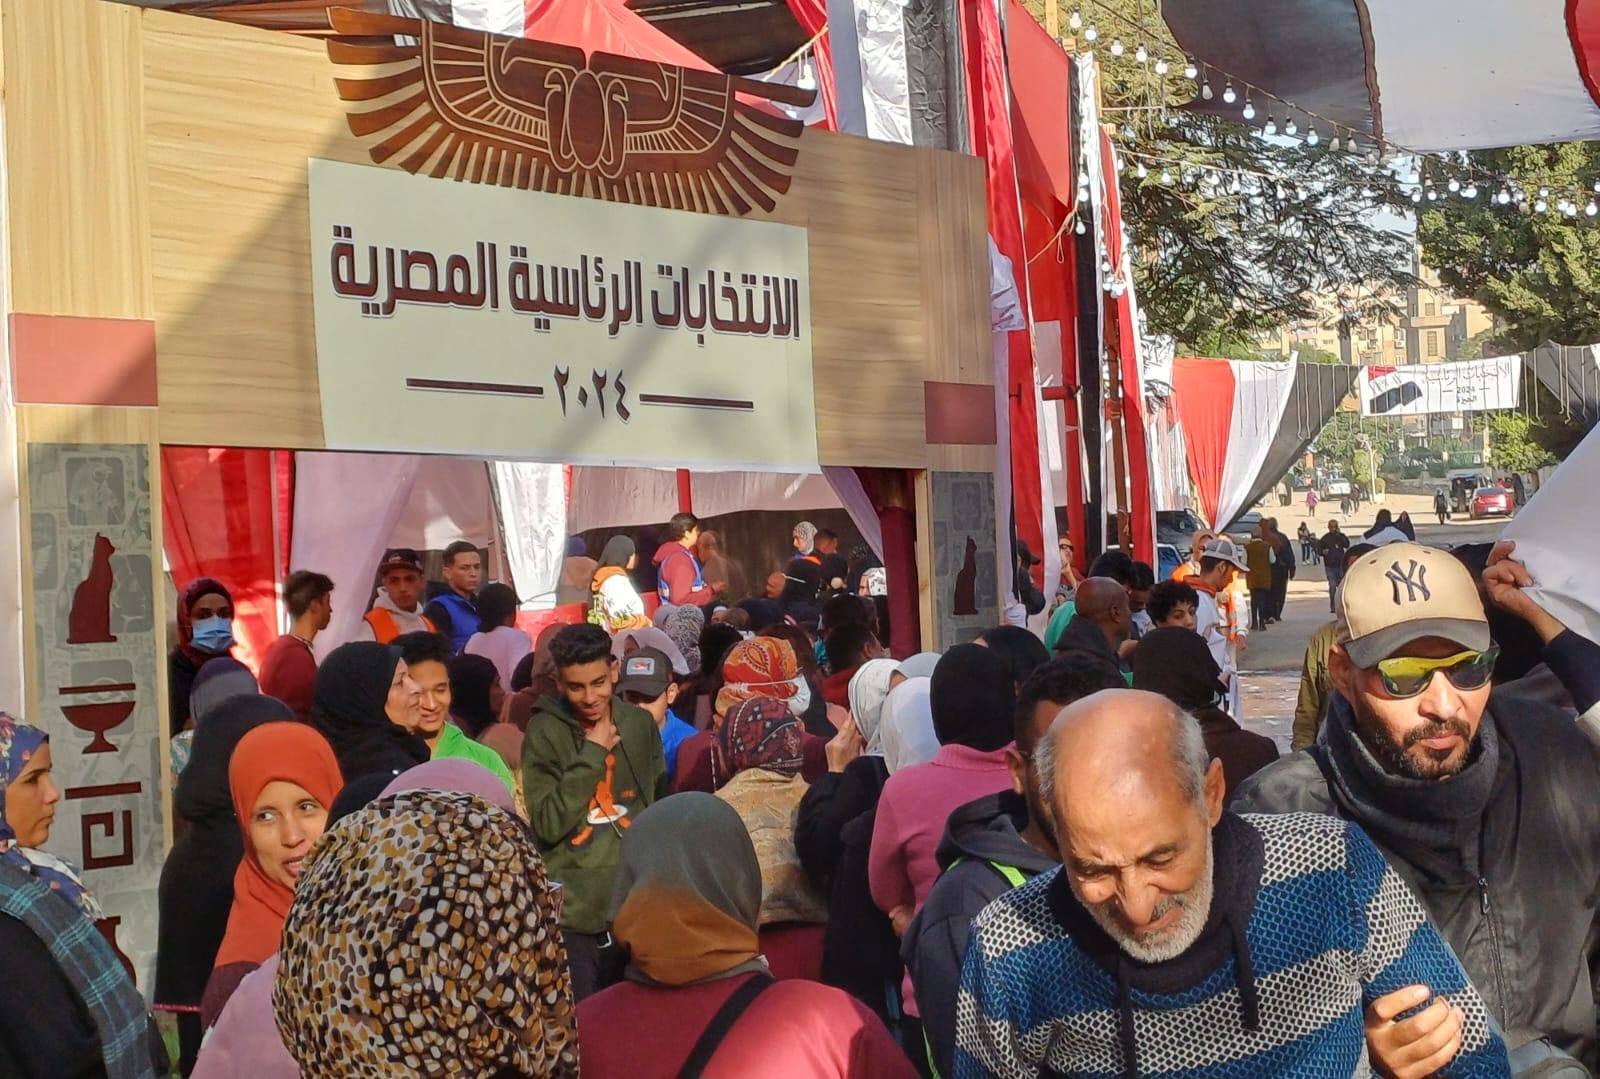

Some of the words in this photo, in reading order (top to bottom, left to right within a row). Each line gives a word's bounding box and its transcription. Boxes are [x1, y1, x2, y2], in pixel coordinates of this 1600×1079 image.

[331, 224, 499, 317] المصرية
[507, 244, 645, 336] الرئاسية
[649, 263, 801, 346] الانتخابات
[553, 364, 632, 424] ٢٠٢٤
[1385, 559, 1431, 606] NY
